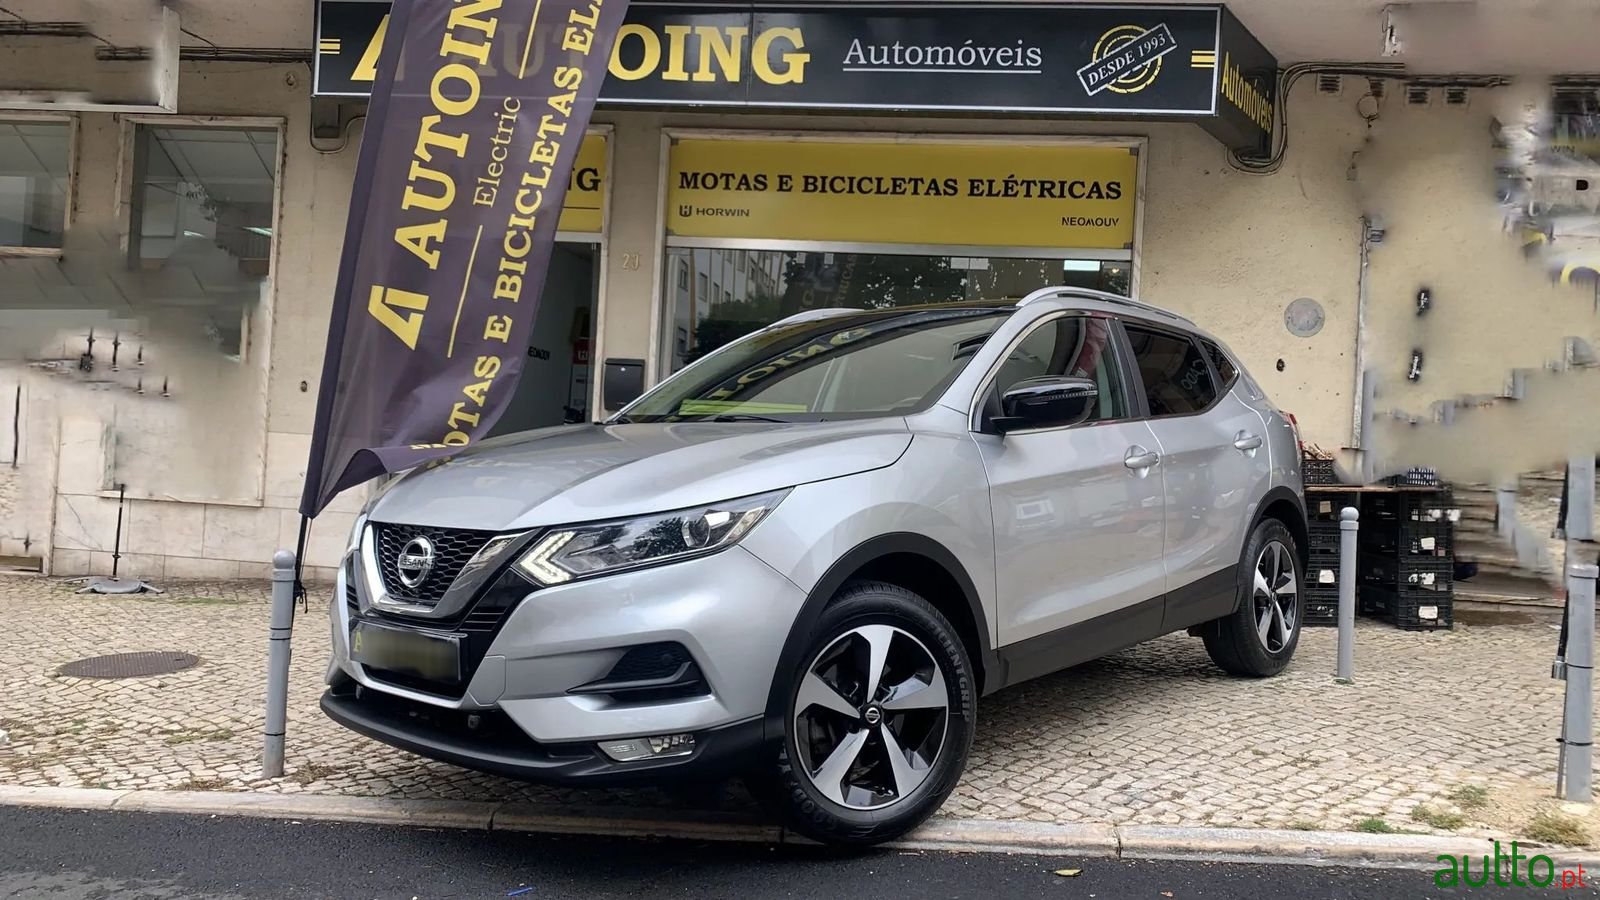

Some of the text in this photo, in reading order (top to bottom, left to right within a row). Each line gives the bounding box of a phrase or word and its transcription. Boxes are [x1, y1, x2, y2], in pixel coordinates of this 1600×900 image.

[843, 38, 1042, 67] Automóveis
[1088, 33, 1166, 86] DESDE 1993
[1222, 51, 1273, 133] Automóveis
[473, 97, 521, 208] Electric
[493, 66, 583, 303] BICICLETAS
[678, 172, 1122, 200] MOTAS E BICICLETAS ELÉTRICAS
[696, 207, 750, 217] HORWIN
[483, 315, 513, 343] E
